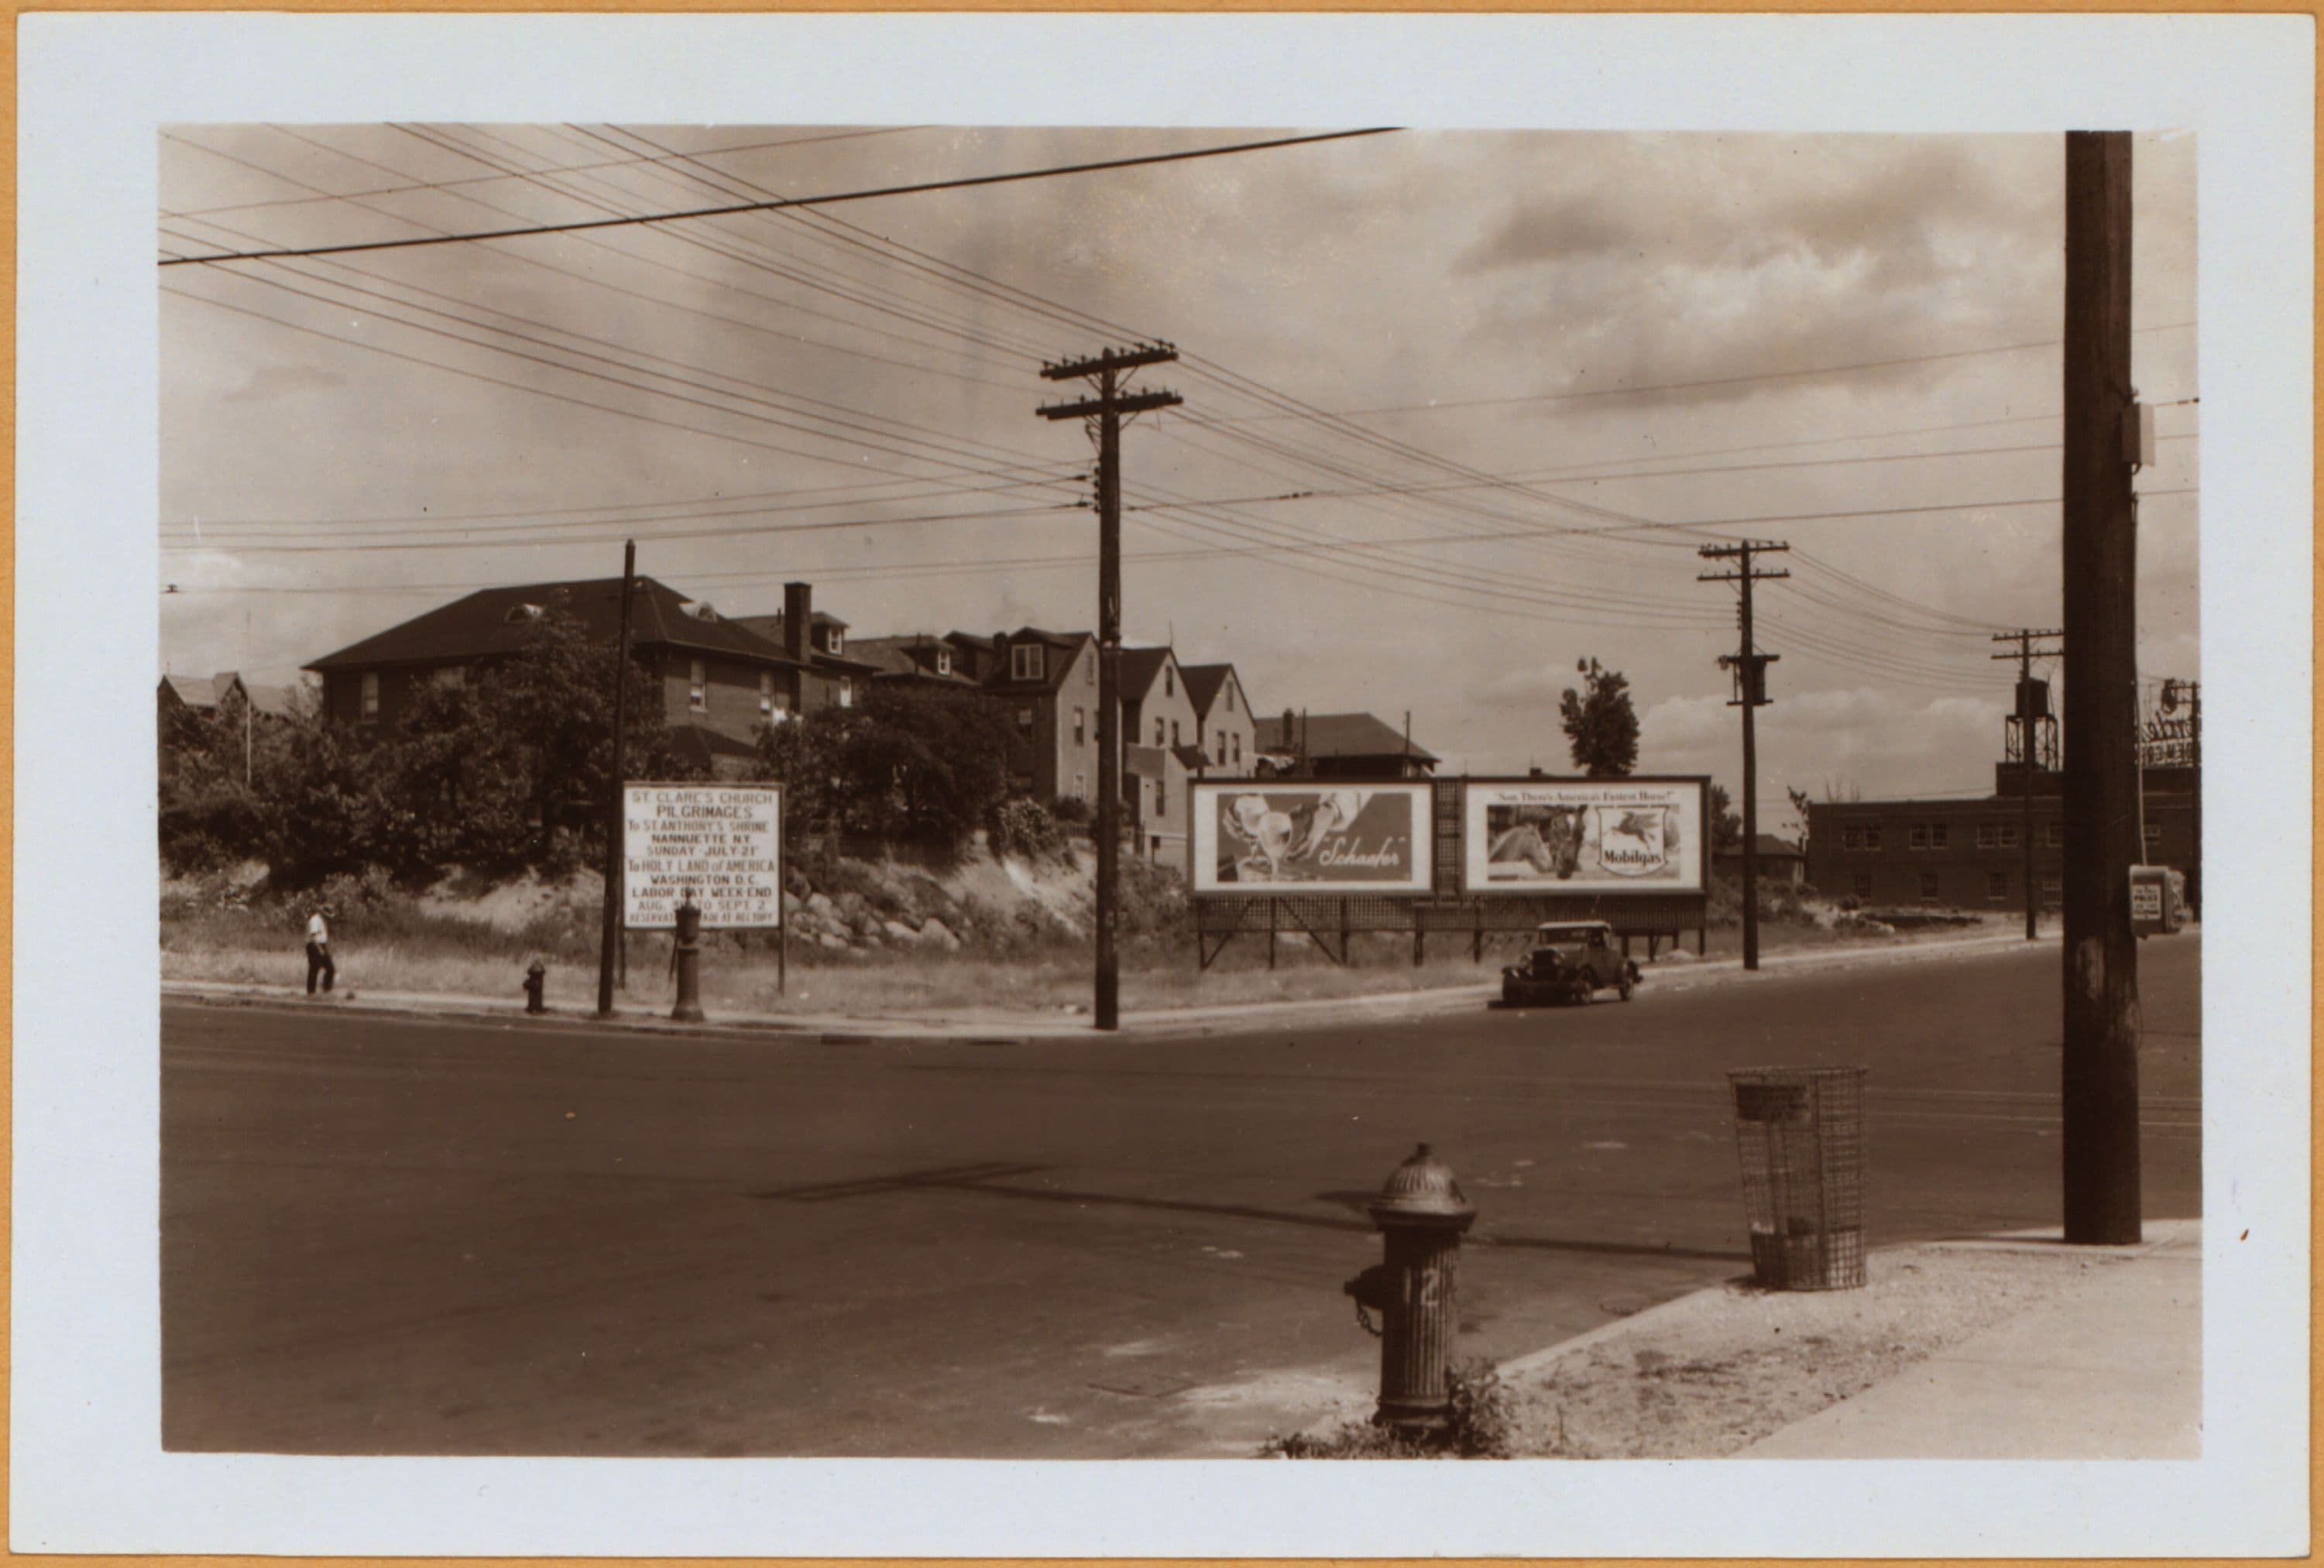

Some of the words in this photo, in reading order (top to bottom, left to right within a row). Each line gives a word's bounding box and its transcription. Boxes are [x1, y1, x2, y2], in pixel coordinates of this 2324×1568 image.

[656, 792, 713, 804] CLARE'S
[719, 793, 772, 805] CHURCH
[657, 805, 753, 818] PILGRIMAGES
[729, 821, 768, 832] SHRINE
[651, 834, 726, 843] NANNUETTE
[647, 846, 695, 856] SUNDAY
[704, 846, 736, 856] JULY
[1604, 849, 1662, 866] Mobilgas
[642, 860, 671, 872] HOLY
[678, 860, 708, 872] LAND
[726, 860, 775, 872] AMERICA
[651, 875, 729, 885] WASHINGTON
[632, 887, 674, 897] LABOR
[681, 887, 704, 897] DAY
